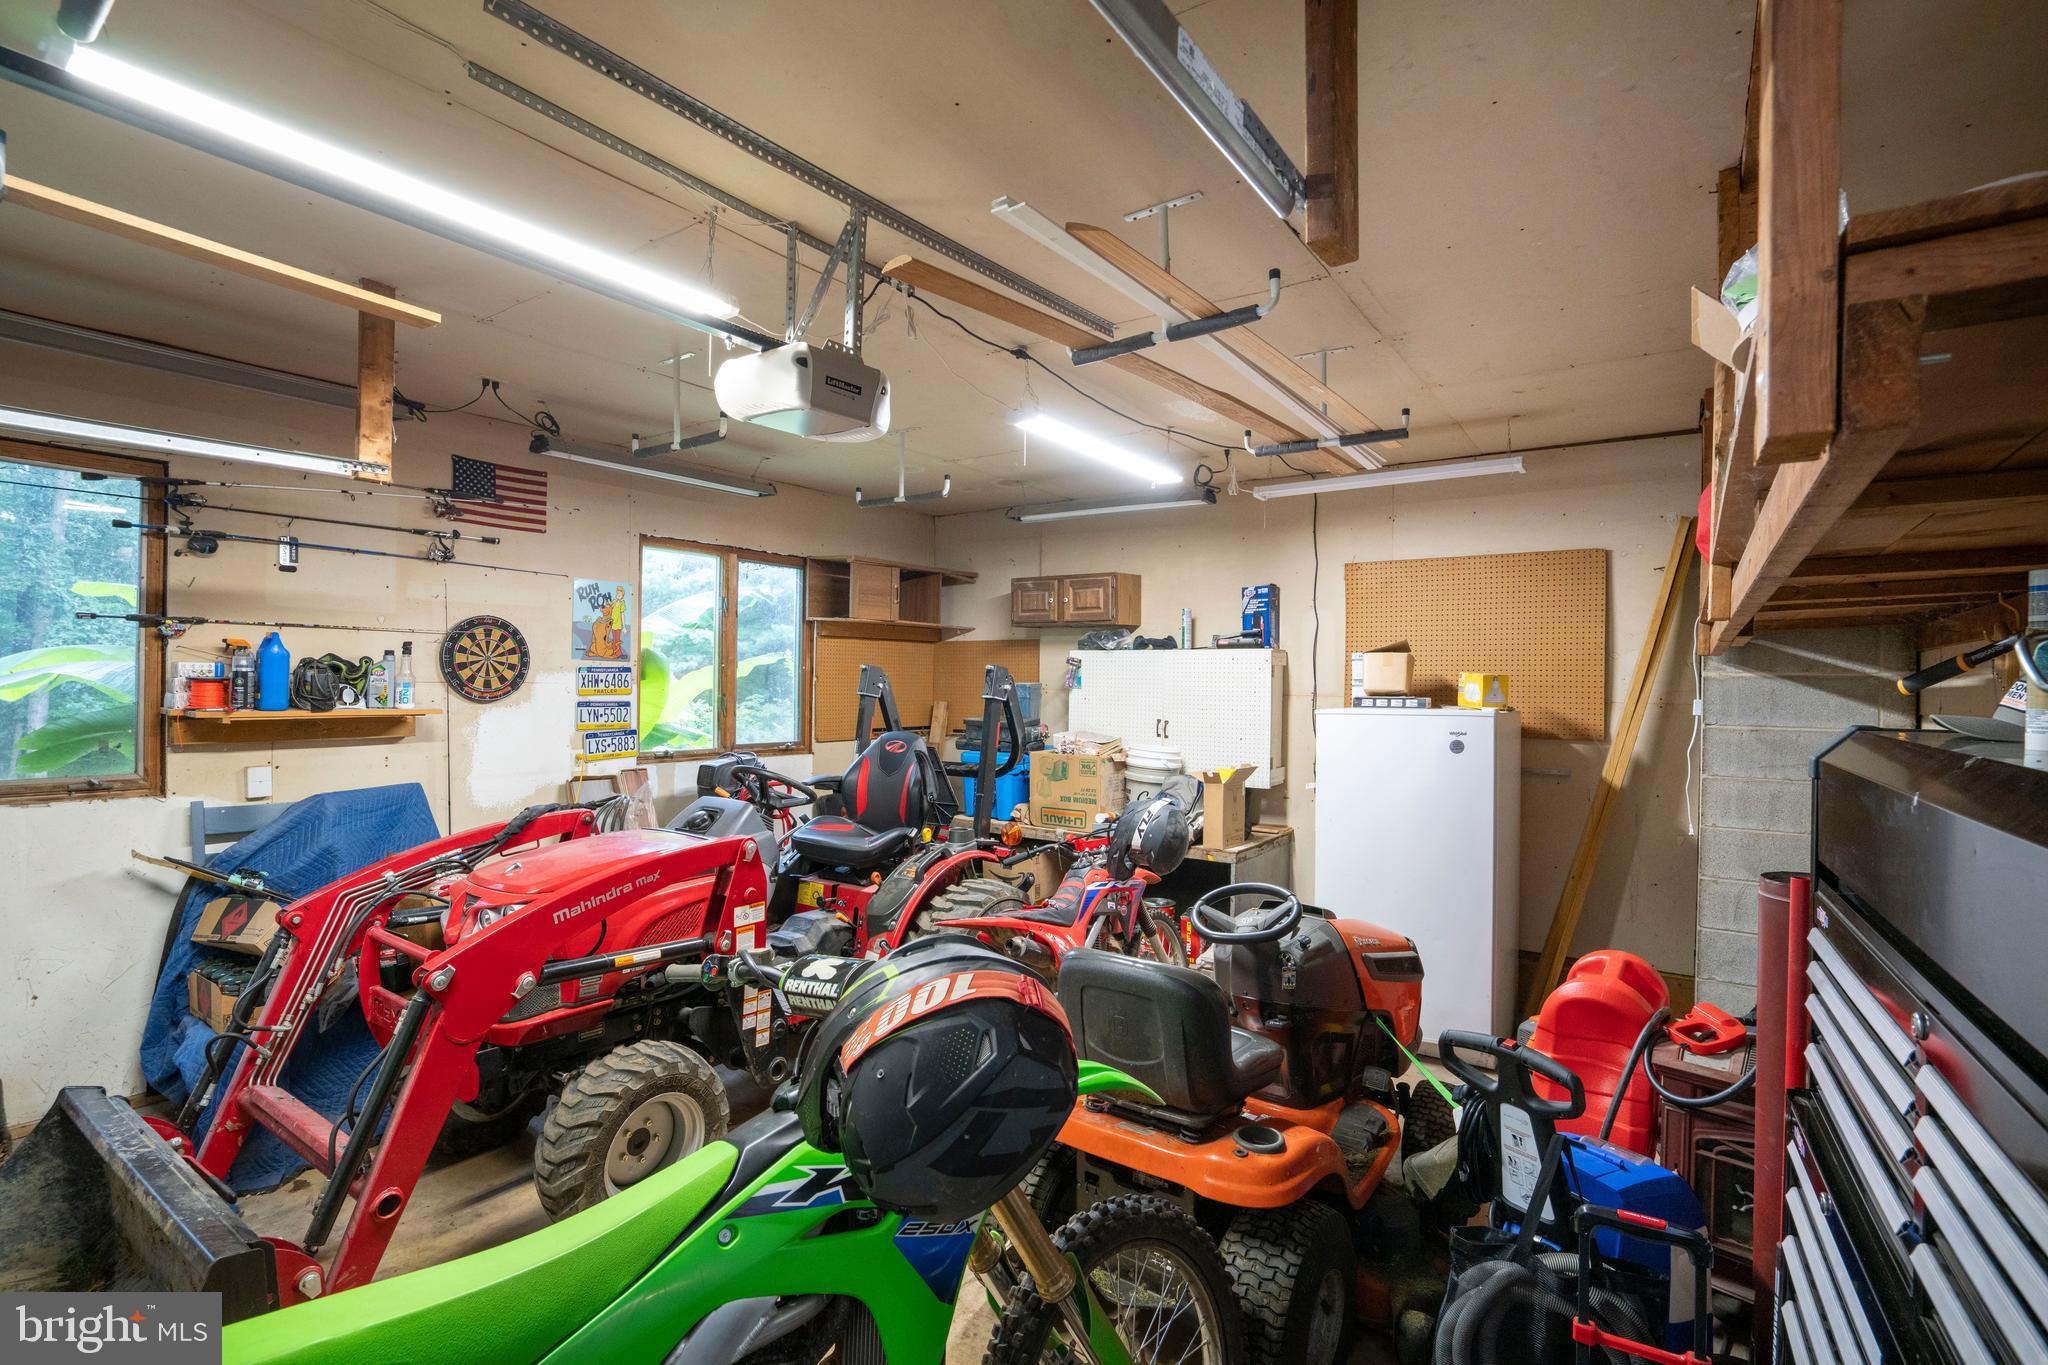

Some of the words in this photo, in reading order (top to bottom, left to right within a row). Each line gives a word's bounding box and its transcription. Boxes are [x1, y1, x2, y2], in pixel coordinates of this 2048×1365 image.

[576, 583, 600, 602] RUH
[588, 591, 613, 612] ROH
[1043, 813, 1083, 826] U-HAUL
[1136, 809, 1154, 839] FLY
[552, 882, 634, 925] Mahindra
[784, 978, 839, 998] RENTHAL
[787, 994, 837, 1011] RENTHA
[897, 1219, 977, 1237] 250X
